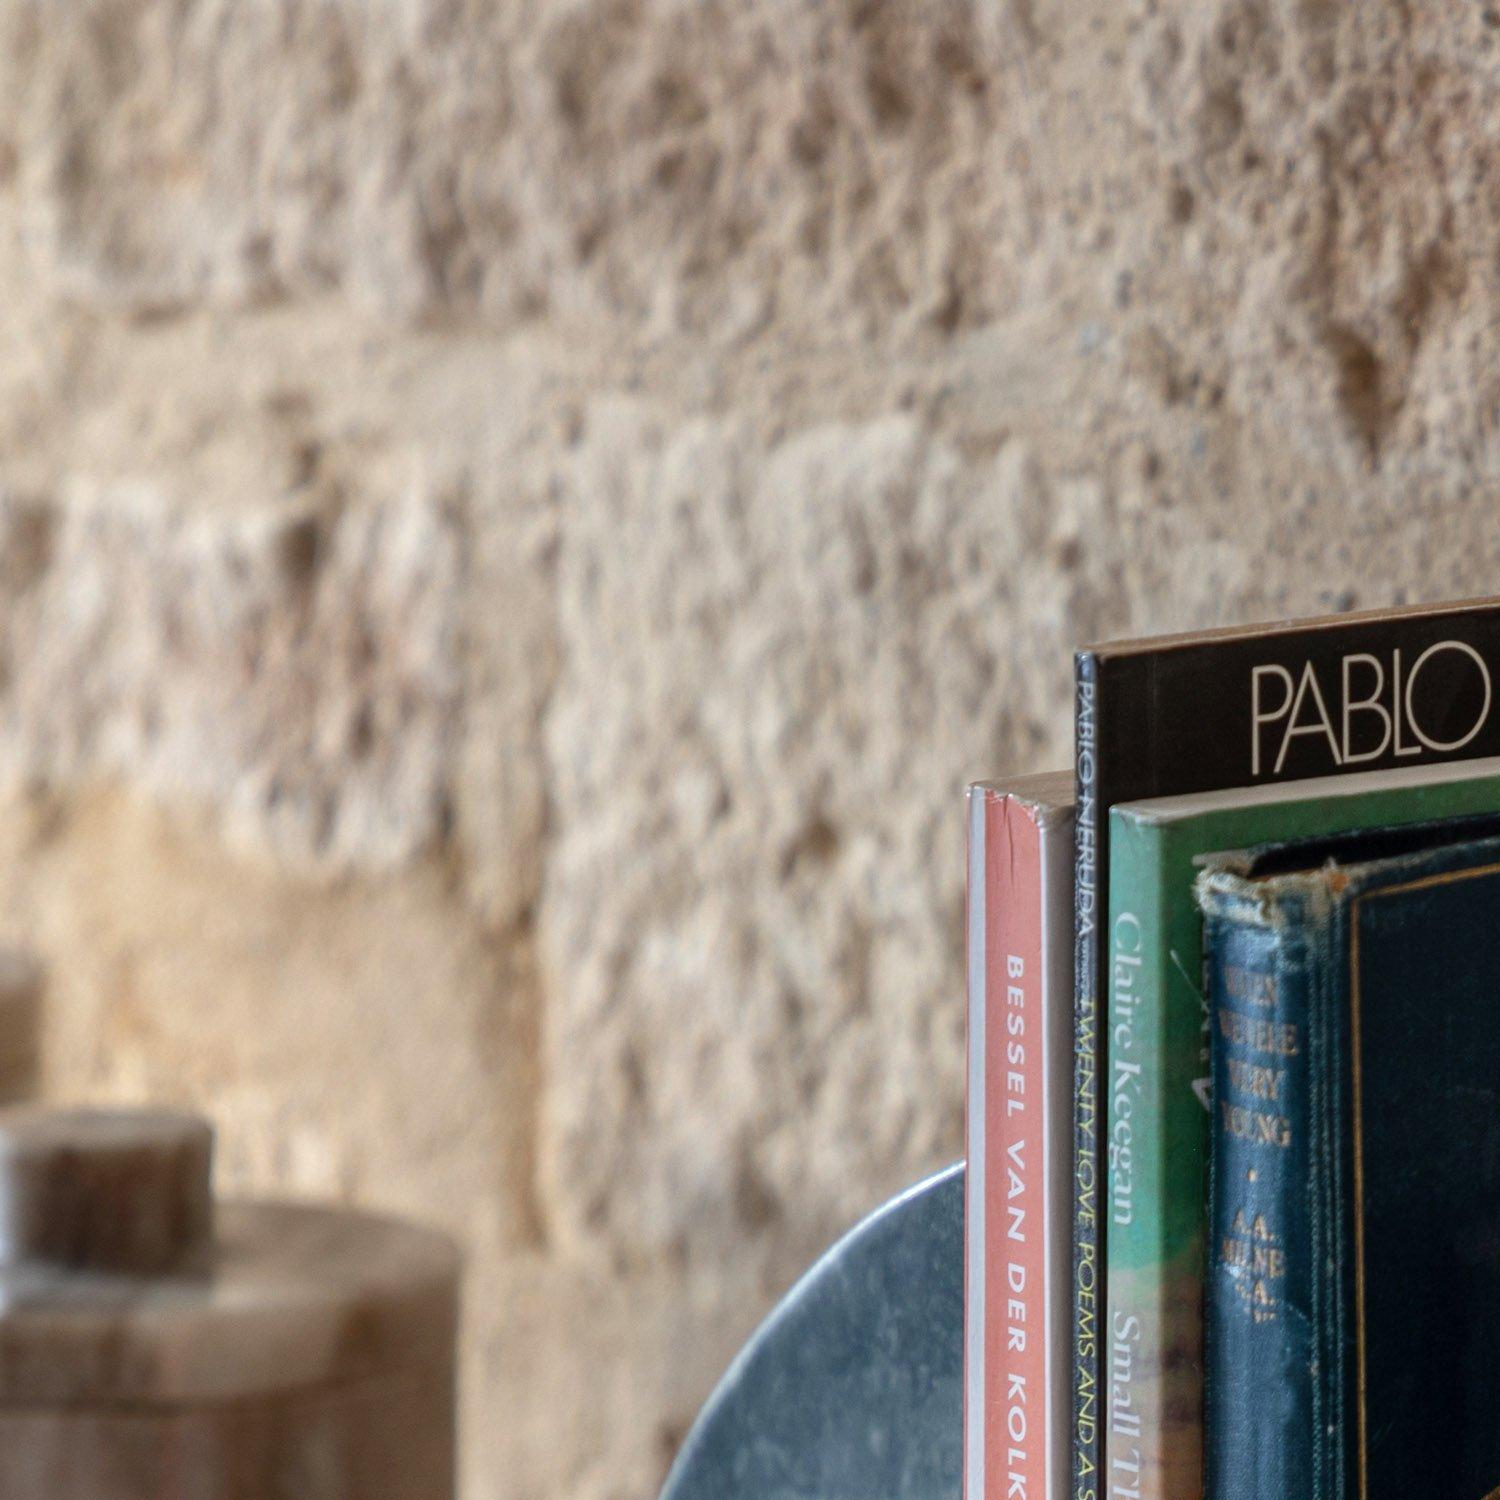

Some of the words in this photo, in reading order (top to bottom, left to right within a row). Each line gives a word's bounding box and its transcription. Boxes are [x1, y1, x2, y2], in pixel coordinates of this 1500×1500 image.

[1078, 680, 1095, 785] PABLO
[1251, 639, 1492, 775] PABLO
[1078, 795, 1095, 936] NERUDA
[1007, 954, 1025, 1117] BESSEL
[1114, 912, 1141, 1051] Claire
[1077, 998, 1096, 1133] TWENTY
[1008, 1139, 1025, 1242] VAN
[1078, 1149, 1095, 1228] LOVE
[1108, 1058, 1141, 1225] Keegan
[1008, 1262, 1025, 1353] DER
[1078, 1242, 1095, 1356] POEMS
[1078, 1366, 1095, 1444] AND
[1111, 1311, 1140, 1437] Small
[1078, 1451, 1095, 1477] A
